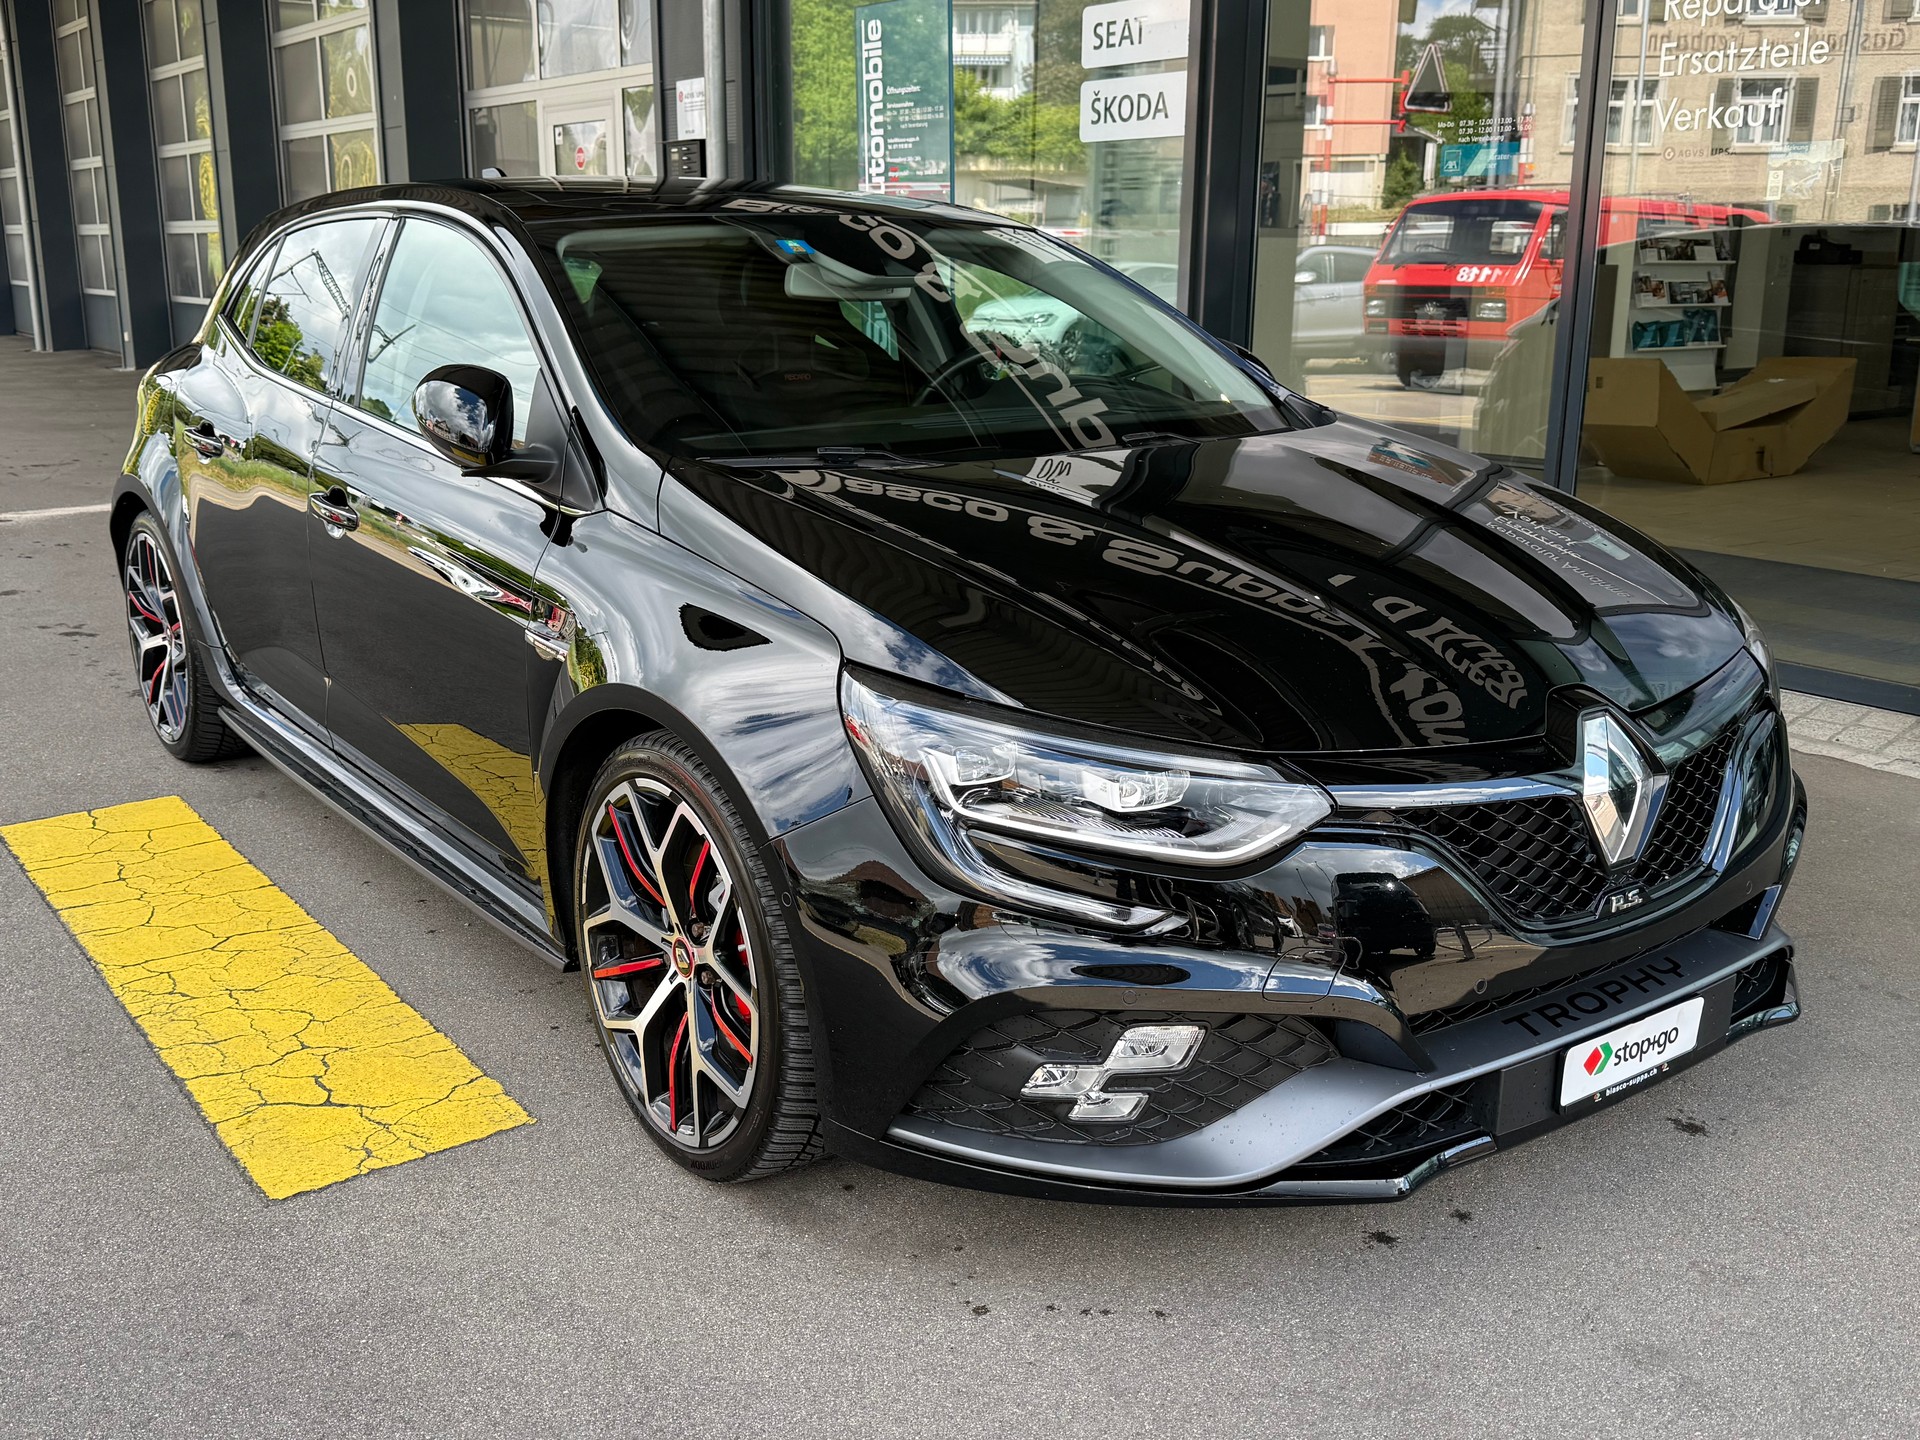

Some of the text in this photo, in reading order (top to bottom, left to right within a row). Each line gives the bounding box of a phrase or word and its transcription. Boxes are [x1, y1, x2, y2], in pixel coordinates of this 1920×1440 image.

[1092, 16, 1148, 50] SEAT
[1658, 27, 1830, 77] Ersatzteile
[862, 19, 885, 194] utomobile
[1090, 90, 1169, 125] ŠKODA
[1655, 87, 1783, 132] Verkauf
[1678, 148, 1705, 158] AGVS
[1502, 956, 1685, 1037] TROPHY
[1613, 1026, 1679, 1067] stop+go
[1605, 1067, 1659, 1097] blasco-suppa.ch
